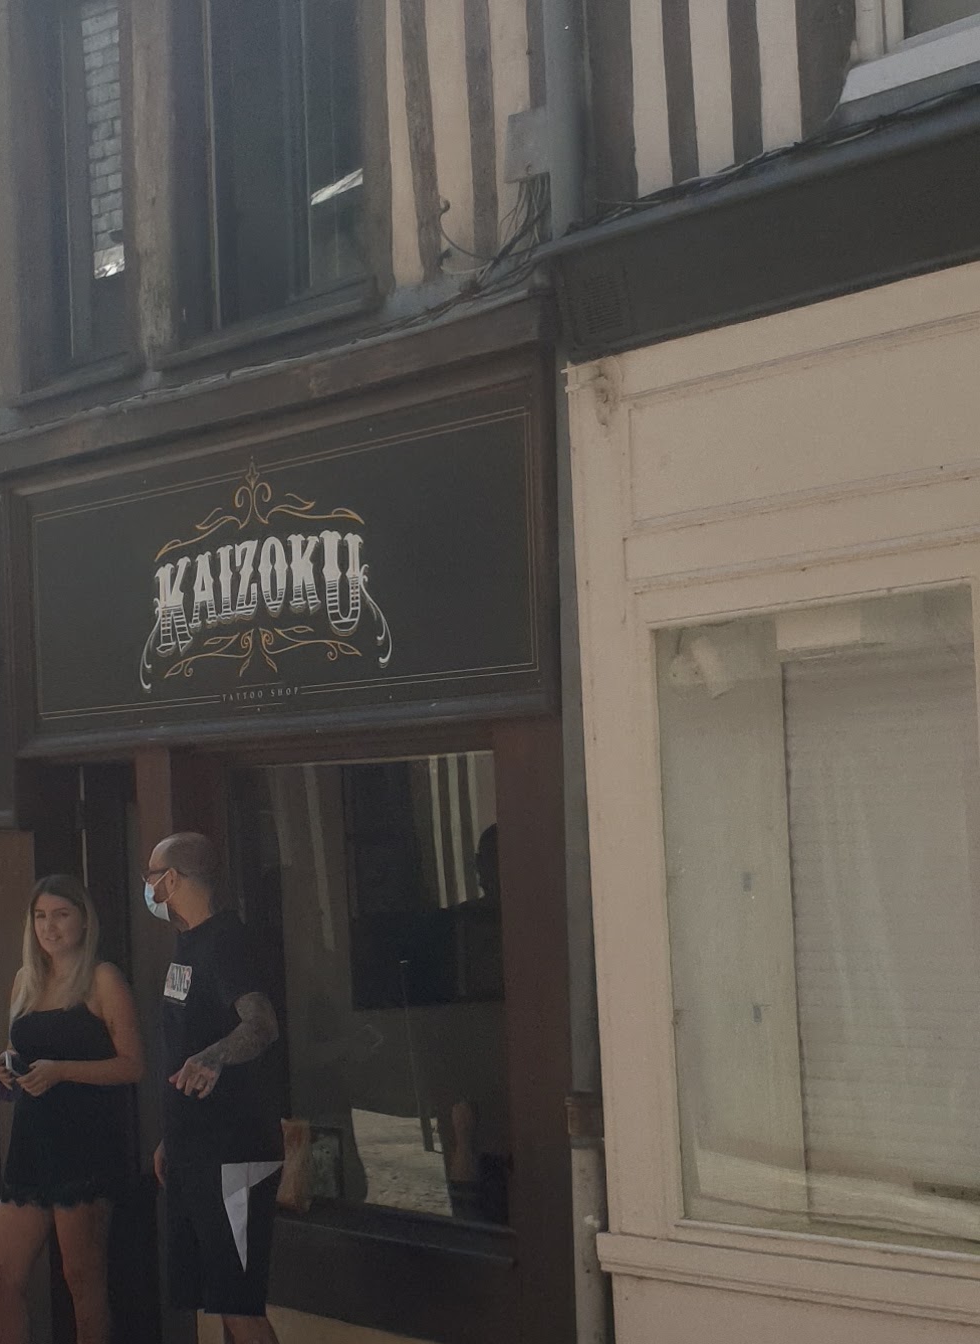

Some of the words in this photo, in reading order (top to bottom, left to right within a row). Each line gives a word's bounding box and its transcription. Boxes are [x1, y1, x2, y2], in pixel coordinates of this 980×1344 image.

[155, 530, 364, 655] KAIZOKU
[222, 689, 263, 703] TATTOO
[270, 686, 299, 698] SHOP
